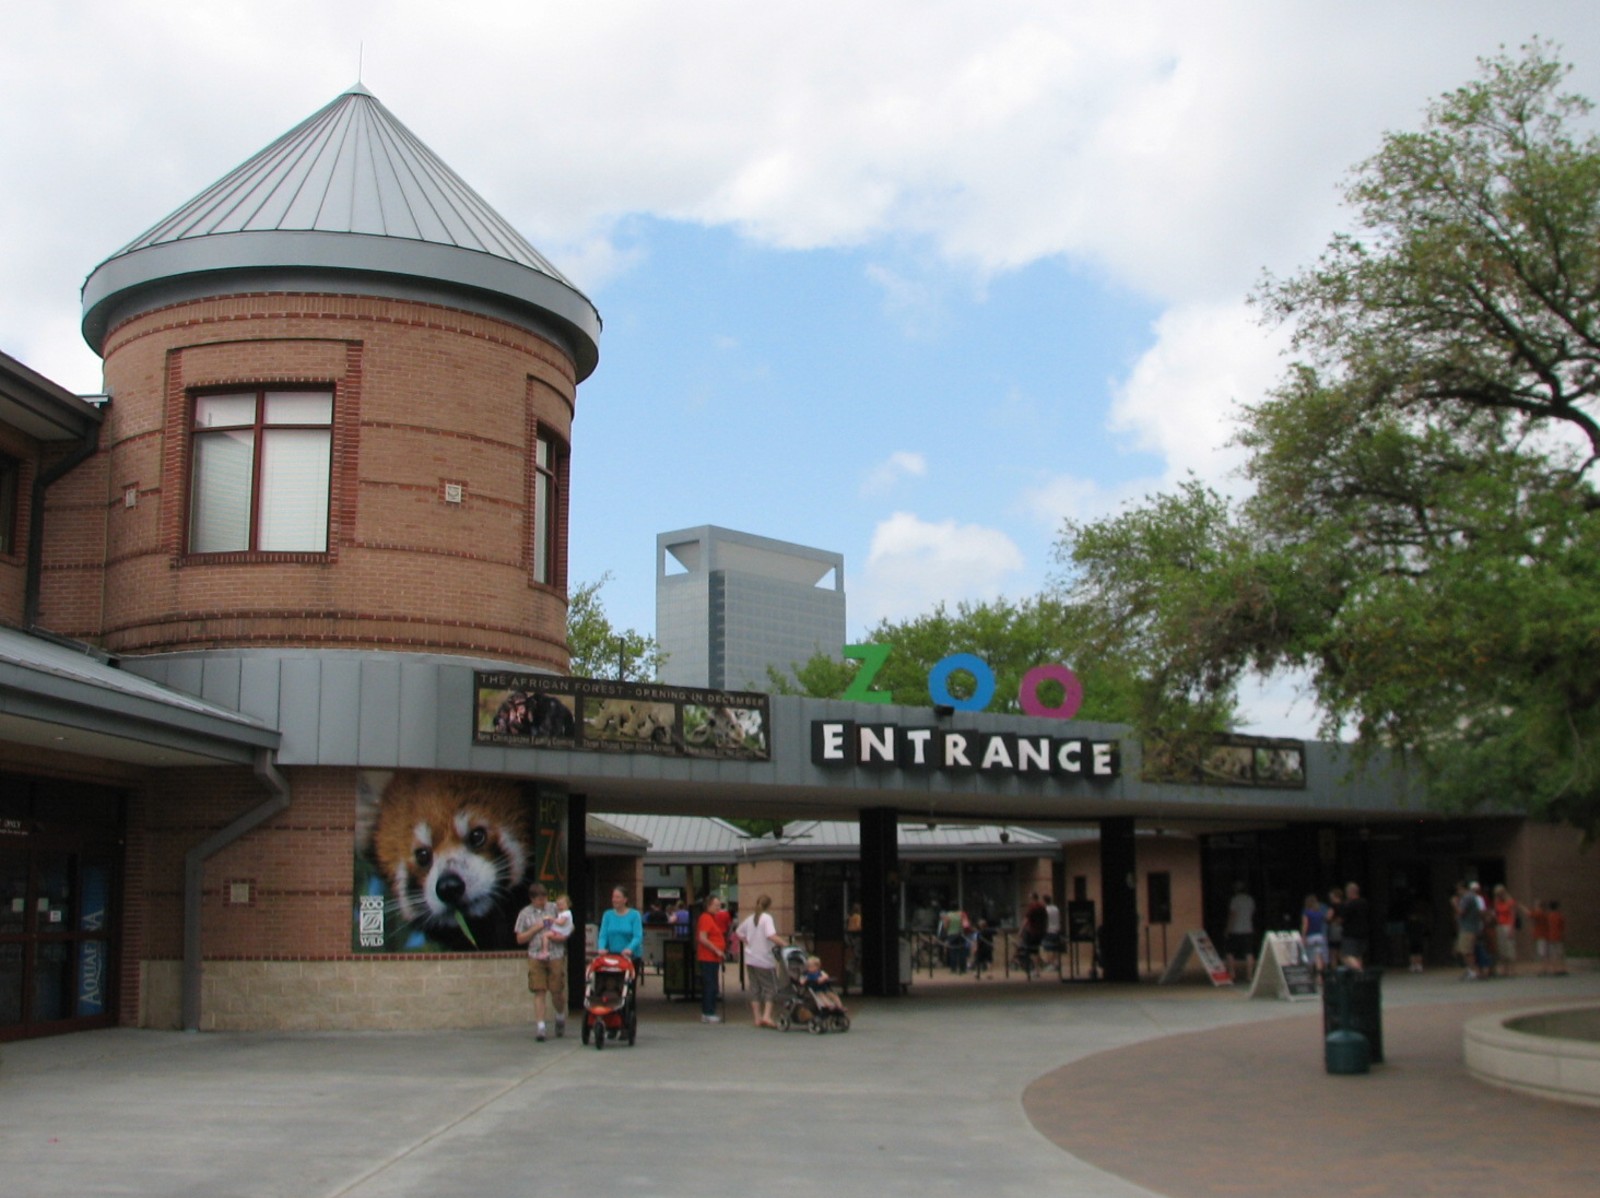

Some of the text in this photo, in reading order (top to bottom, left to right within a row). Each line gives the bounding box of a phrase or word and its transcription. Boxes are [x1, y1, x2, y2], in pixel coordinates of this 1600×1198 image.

[480, 674, 506, 686] THE
[511, 676, 569, 692] AFRICAN
[574, 682, 624, 697] FOREST
[635, 688, 687, 702] OPENING
[691, 692, 703, 702] IN
[707, 694, 765, 706] DECEMBER
[842, 643, 1084, 719] ZOO
[822, 723, 1112, 775] ENTRANCE
[361, 899, 384, 909] ZOO
